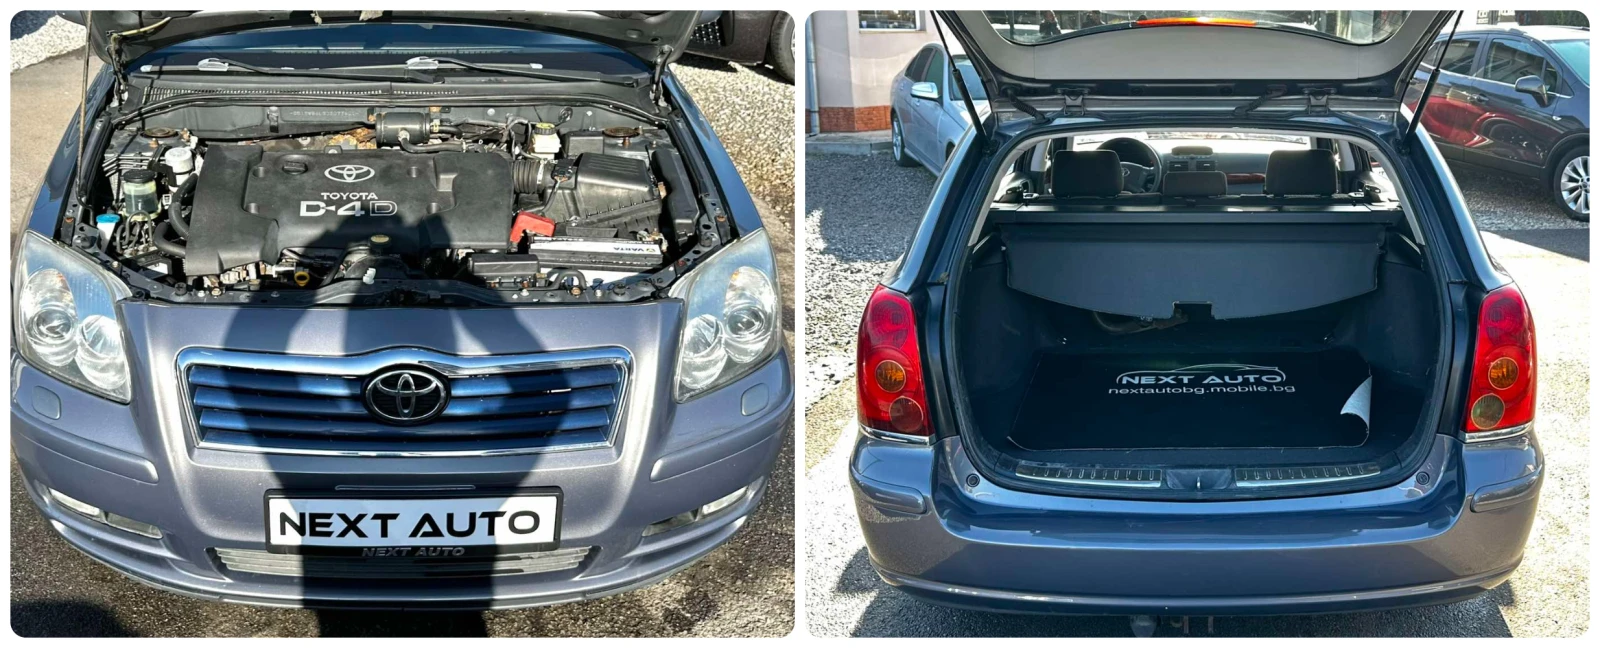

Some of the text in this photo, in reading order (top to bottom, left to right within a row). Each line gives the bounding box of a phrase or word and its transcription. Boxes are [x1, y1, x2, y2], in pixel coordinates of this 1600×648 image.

[320, 192, 379, 200] TOYOTA
[299, 200, 398, 217] D-4D
[1121, 374, 1282, 385] NEXT AUTO
[1108, 384, 1296, 395] nextautobg.mobile.bg
[279, 510, 541, 538] NEXT AUTO
[361, 546, 466, 557] NEXT AUTO
